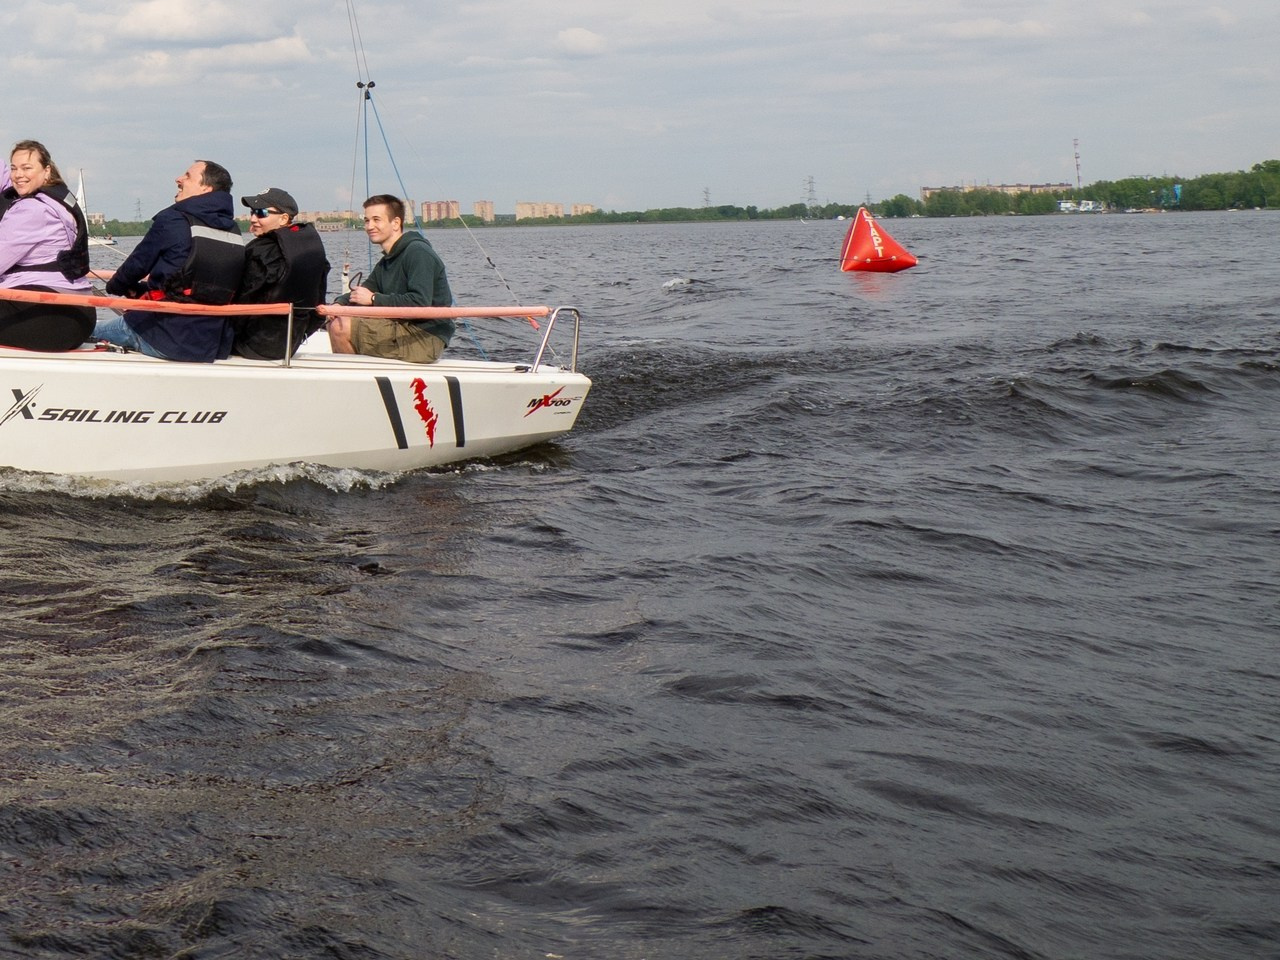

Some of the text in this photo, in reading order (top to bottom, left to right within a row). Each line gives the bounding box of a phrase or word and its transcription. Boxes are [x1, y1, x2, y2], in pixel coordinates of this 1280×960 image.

[862, 210, 884, 258] СТАРТ
[37, 408, 155, 424] SAILING
[158, 411, 228, 424] CLUB
